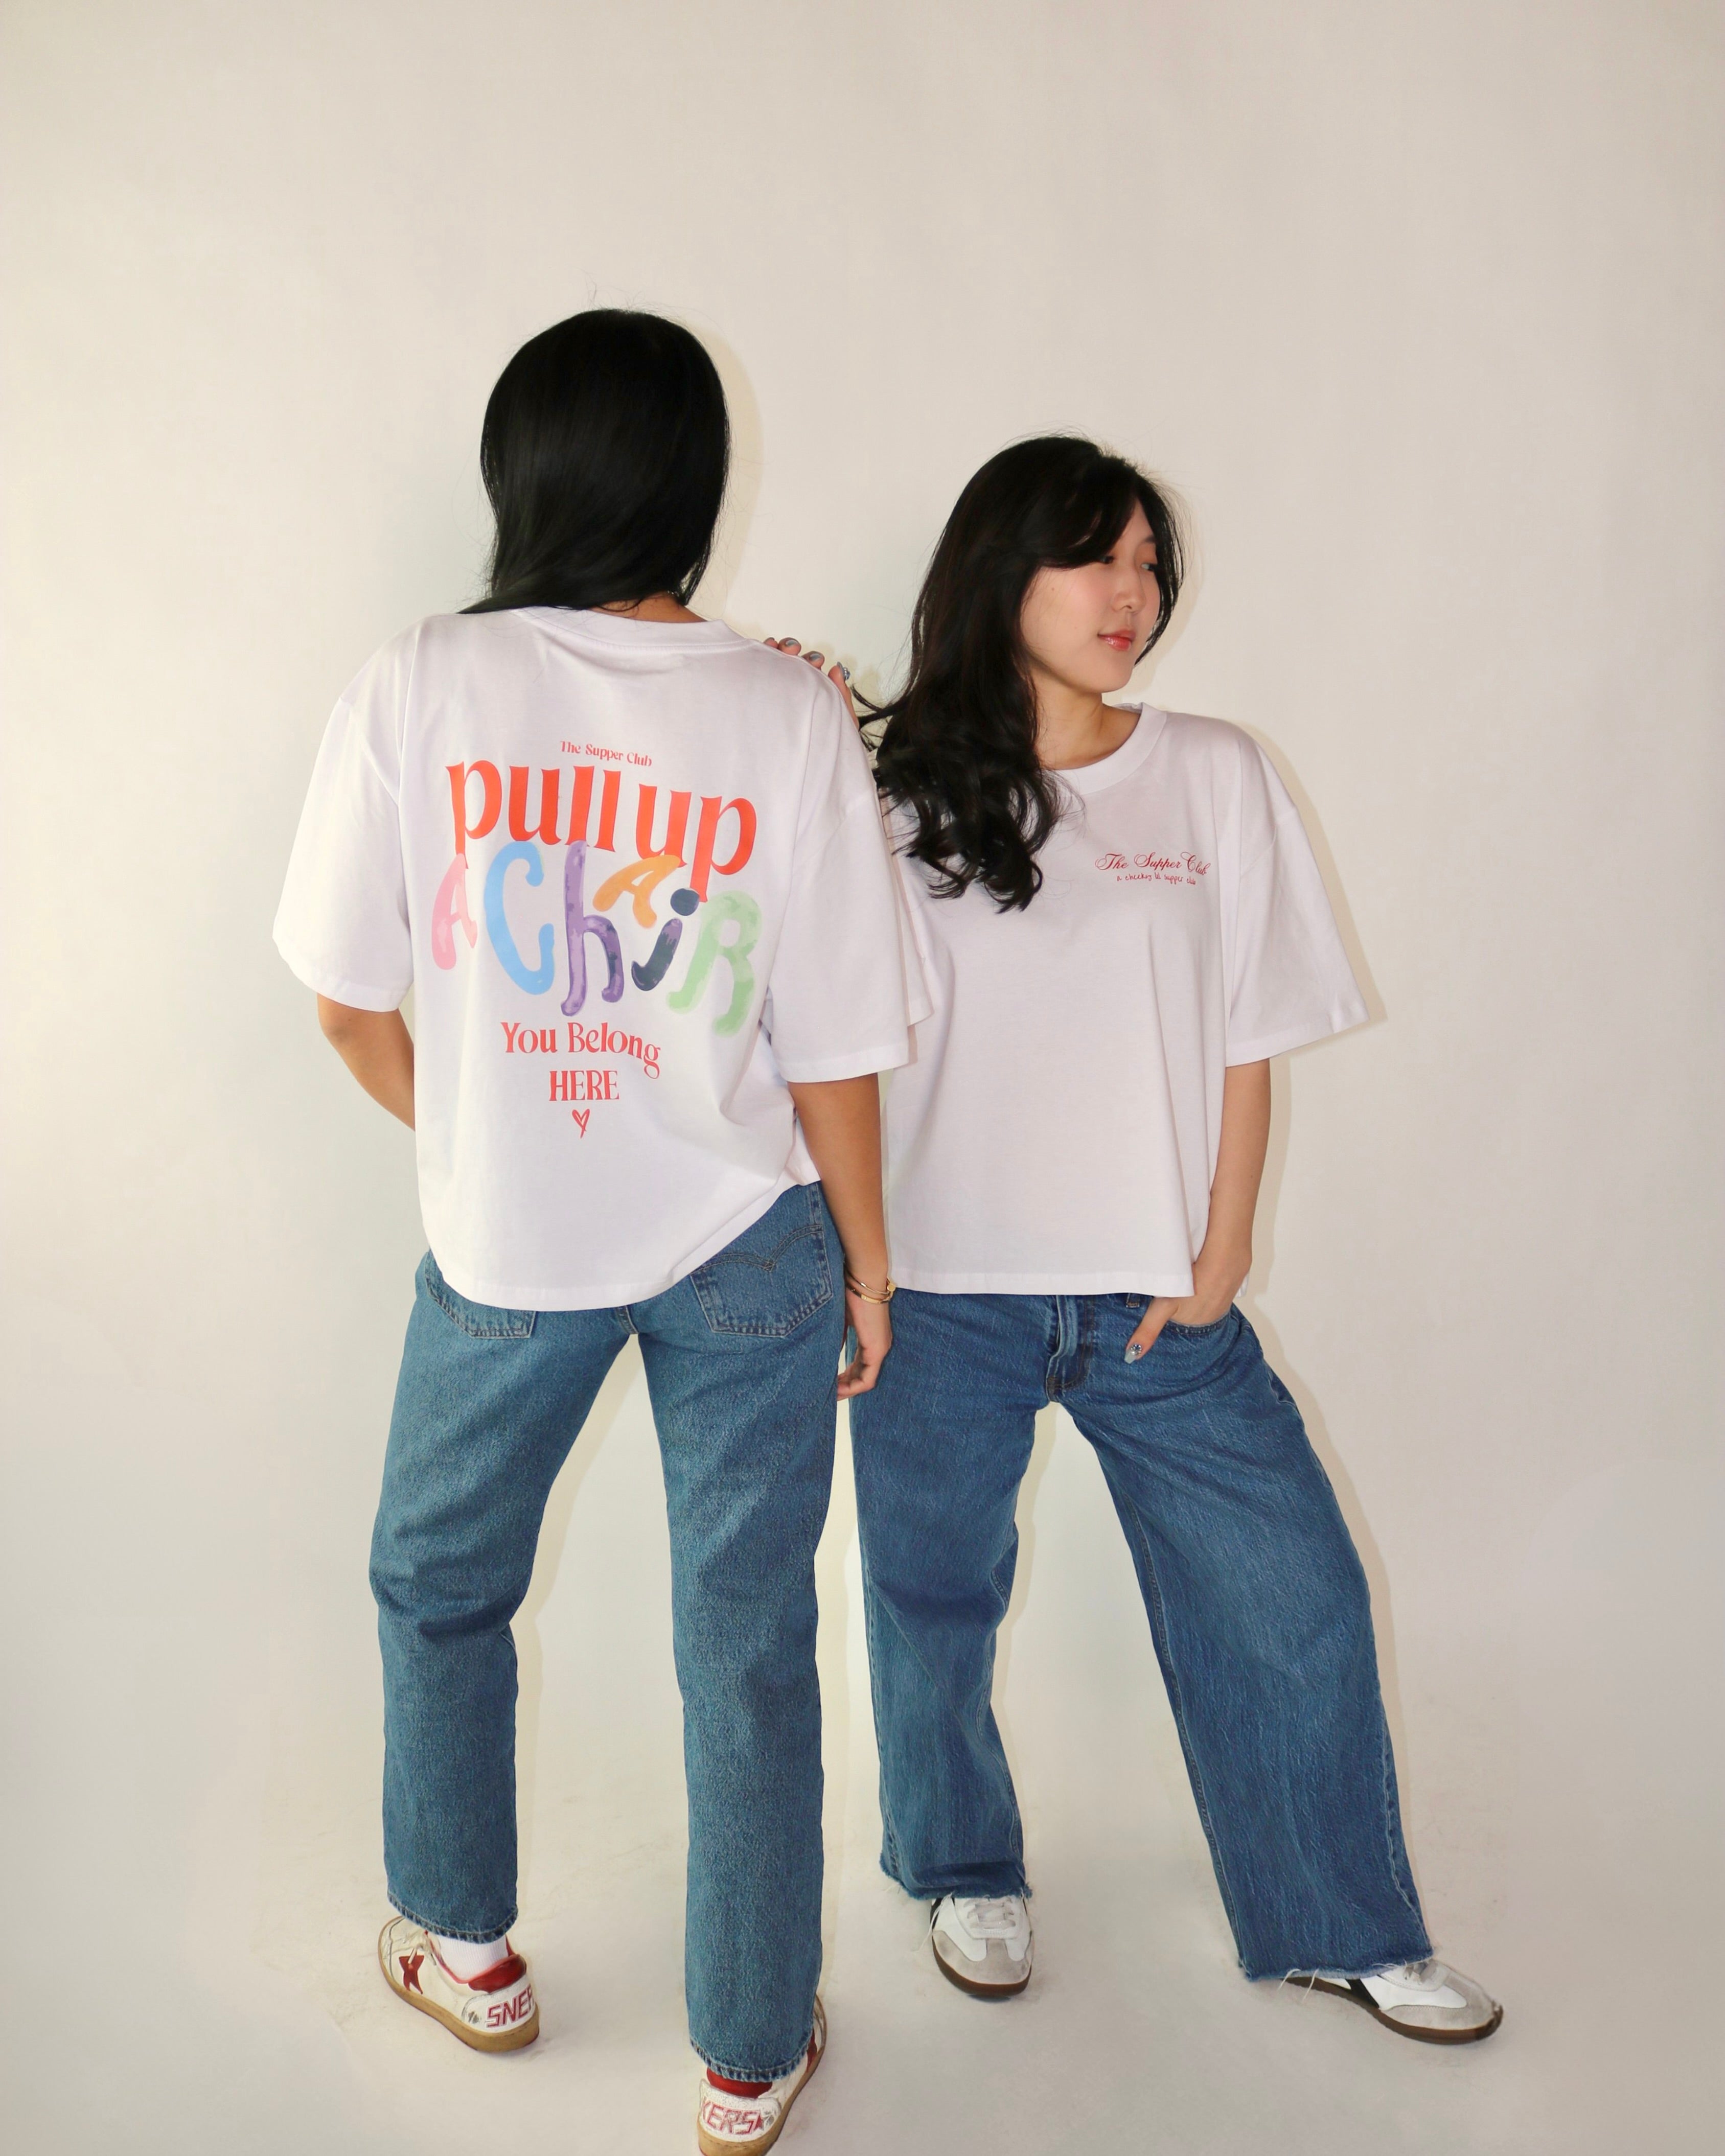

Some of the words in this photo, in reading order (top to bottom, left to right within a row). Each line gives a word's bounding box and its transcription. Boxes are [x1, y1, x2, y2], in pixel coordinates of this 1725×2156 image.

[561, 741, 581, 754] The
[586, 744, 623, 760] Supper
[627, 752, 652, 767] Club
[445, 760, 621, 869] pull
[635, 783, 757, 903] up
[1095, 853, 1129, 870] The
[1134, 852, 1182, 871] Supper
[1180, 851, 1211, 875] Club
[1125, 873, 1152, 881] cheeky
[1164, 874, 1184, 885] supper
[431, 853, 477, 970] A
[500, 1022, 558, 1054] You
[567, 1022, 661, 1079] Belong
[549, 1070, 620, 1101] HERE
